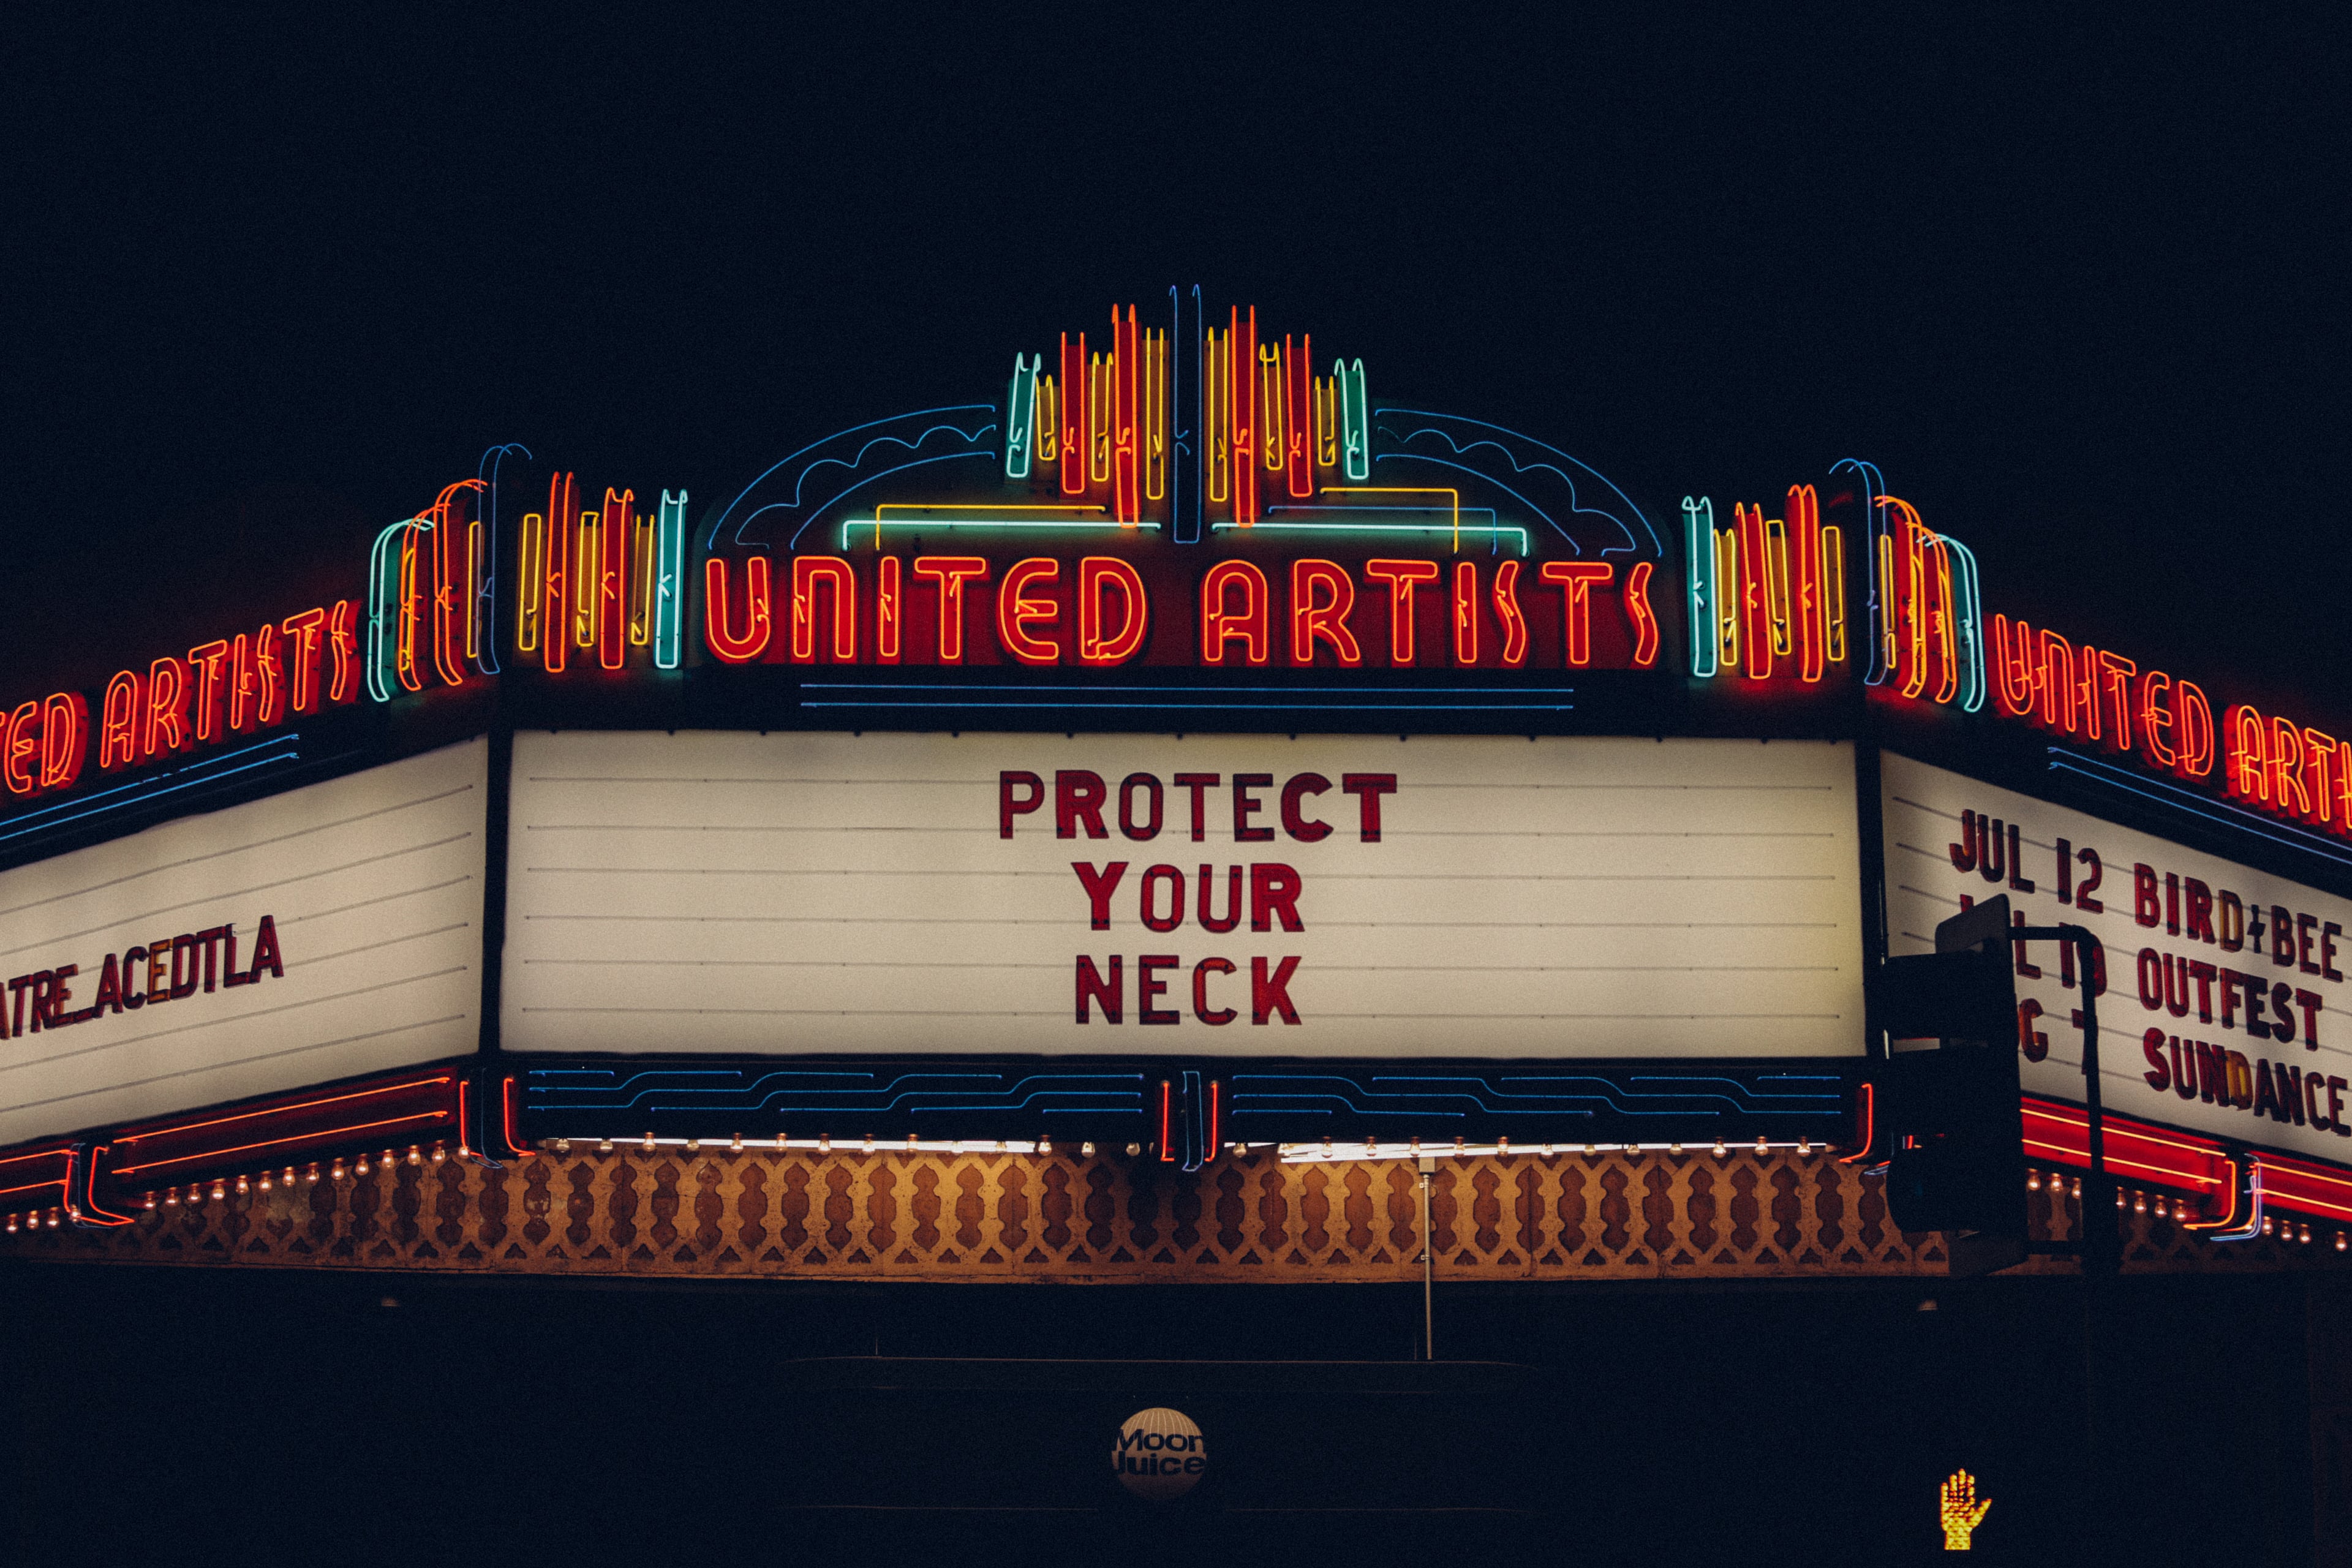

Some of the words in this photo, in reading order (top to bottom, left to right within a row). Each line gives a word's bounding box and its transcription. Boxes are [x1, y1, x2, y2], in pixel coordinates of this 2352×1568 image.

[705, 556, 1147, 662] UNITED
[1202, 559, 1659, 665] ARTISTS
[0, 692, 85, 794] ED
[100, 599, 352, 769] ARTISTS
[1994, 612, 2215, 777] UNITED
[999, 769, 1398, 843] PROTECT
[1070, 861, 1305, 934] YOUR
[1949, 809, 2035, 893] JUL
[2056, 837, 2104, 914] 12
[1076, 954, 1302, 1026] NECK
[2137, 947, 2323, 1052] OUTFEST
[2143, 1027, 2352, 1137] SUNDANCE
[1112, 1428, 1207, 1454] Moon
[1115, 1451, 1207, 1476] Juice
